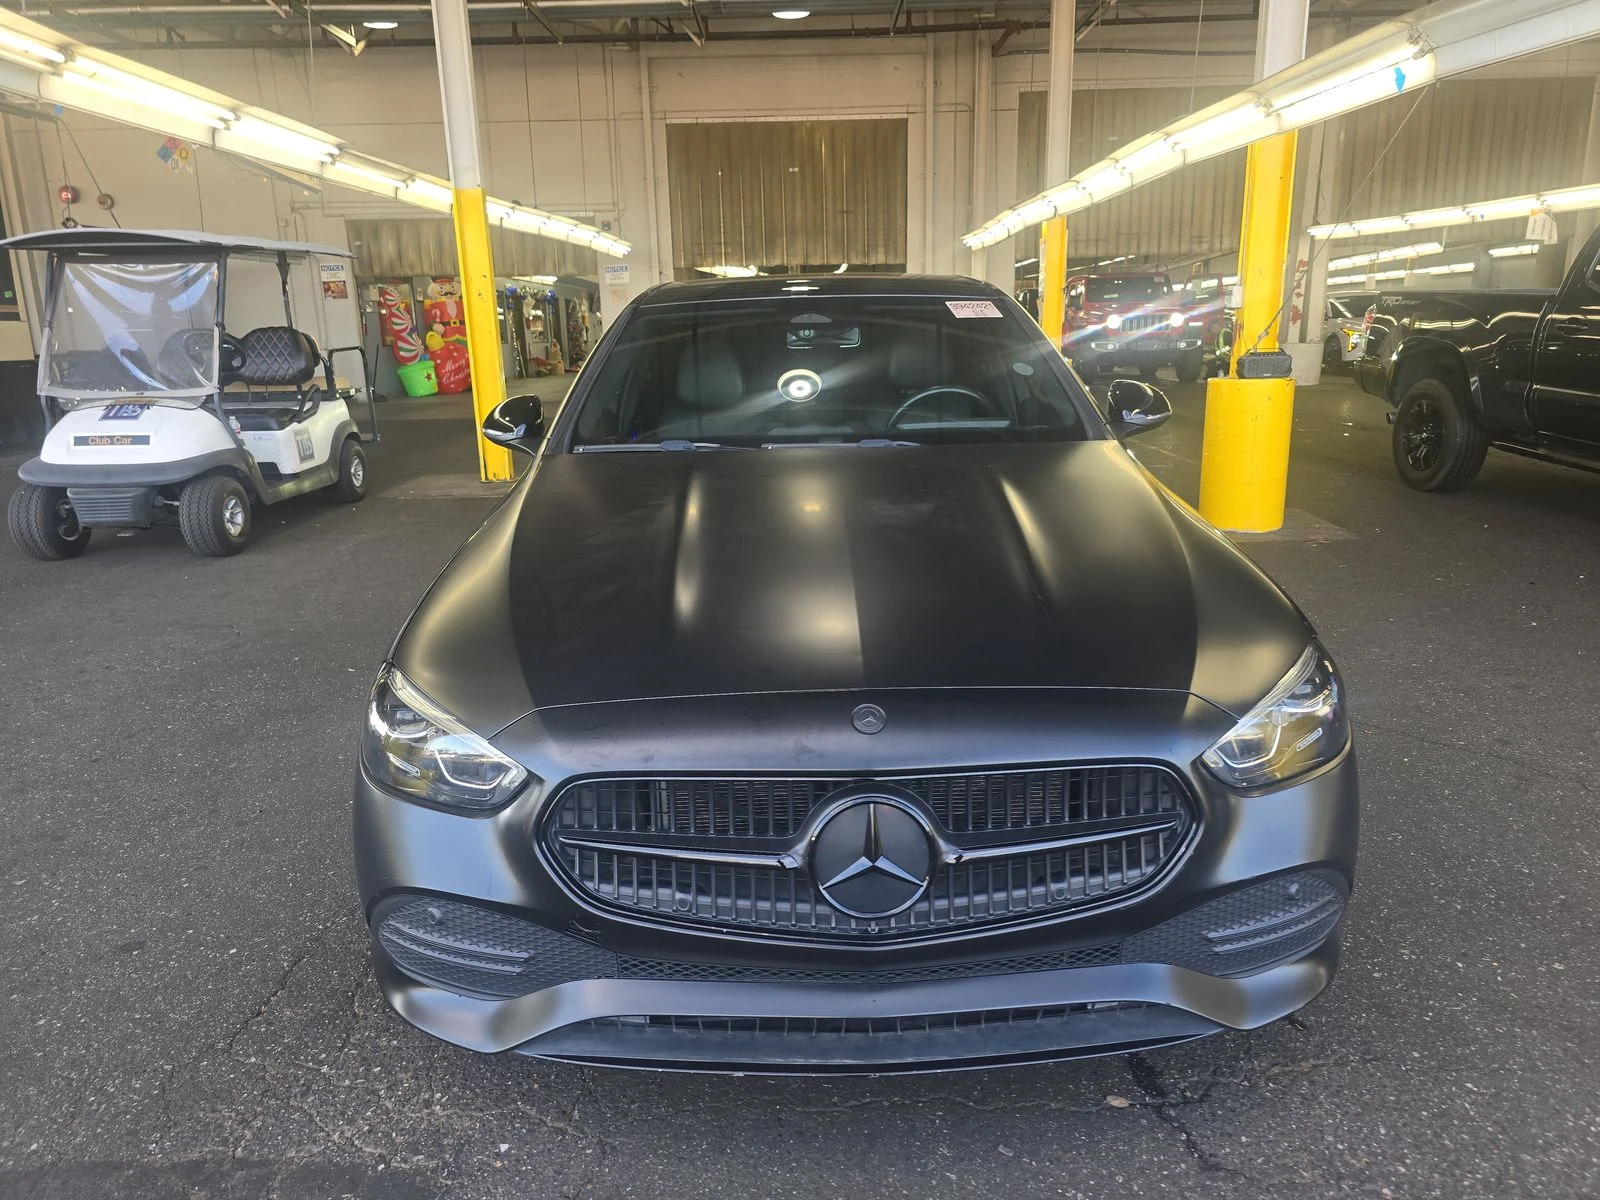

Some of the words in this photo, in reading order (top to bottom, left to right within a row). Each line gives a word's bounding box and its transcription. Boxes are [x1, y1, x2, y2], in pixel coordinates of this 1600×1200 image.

[445, 359, 466, 372] Merry
[88, 436, 111, 446] Club
[113, 436, 132, 445] Car
